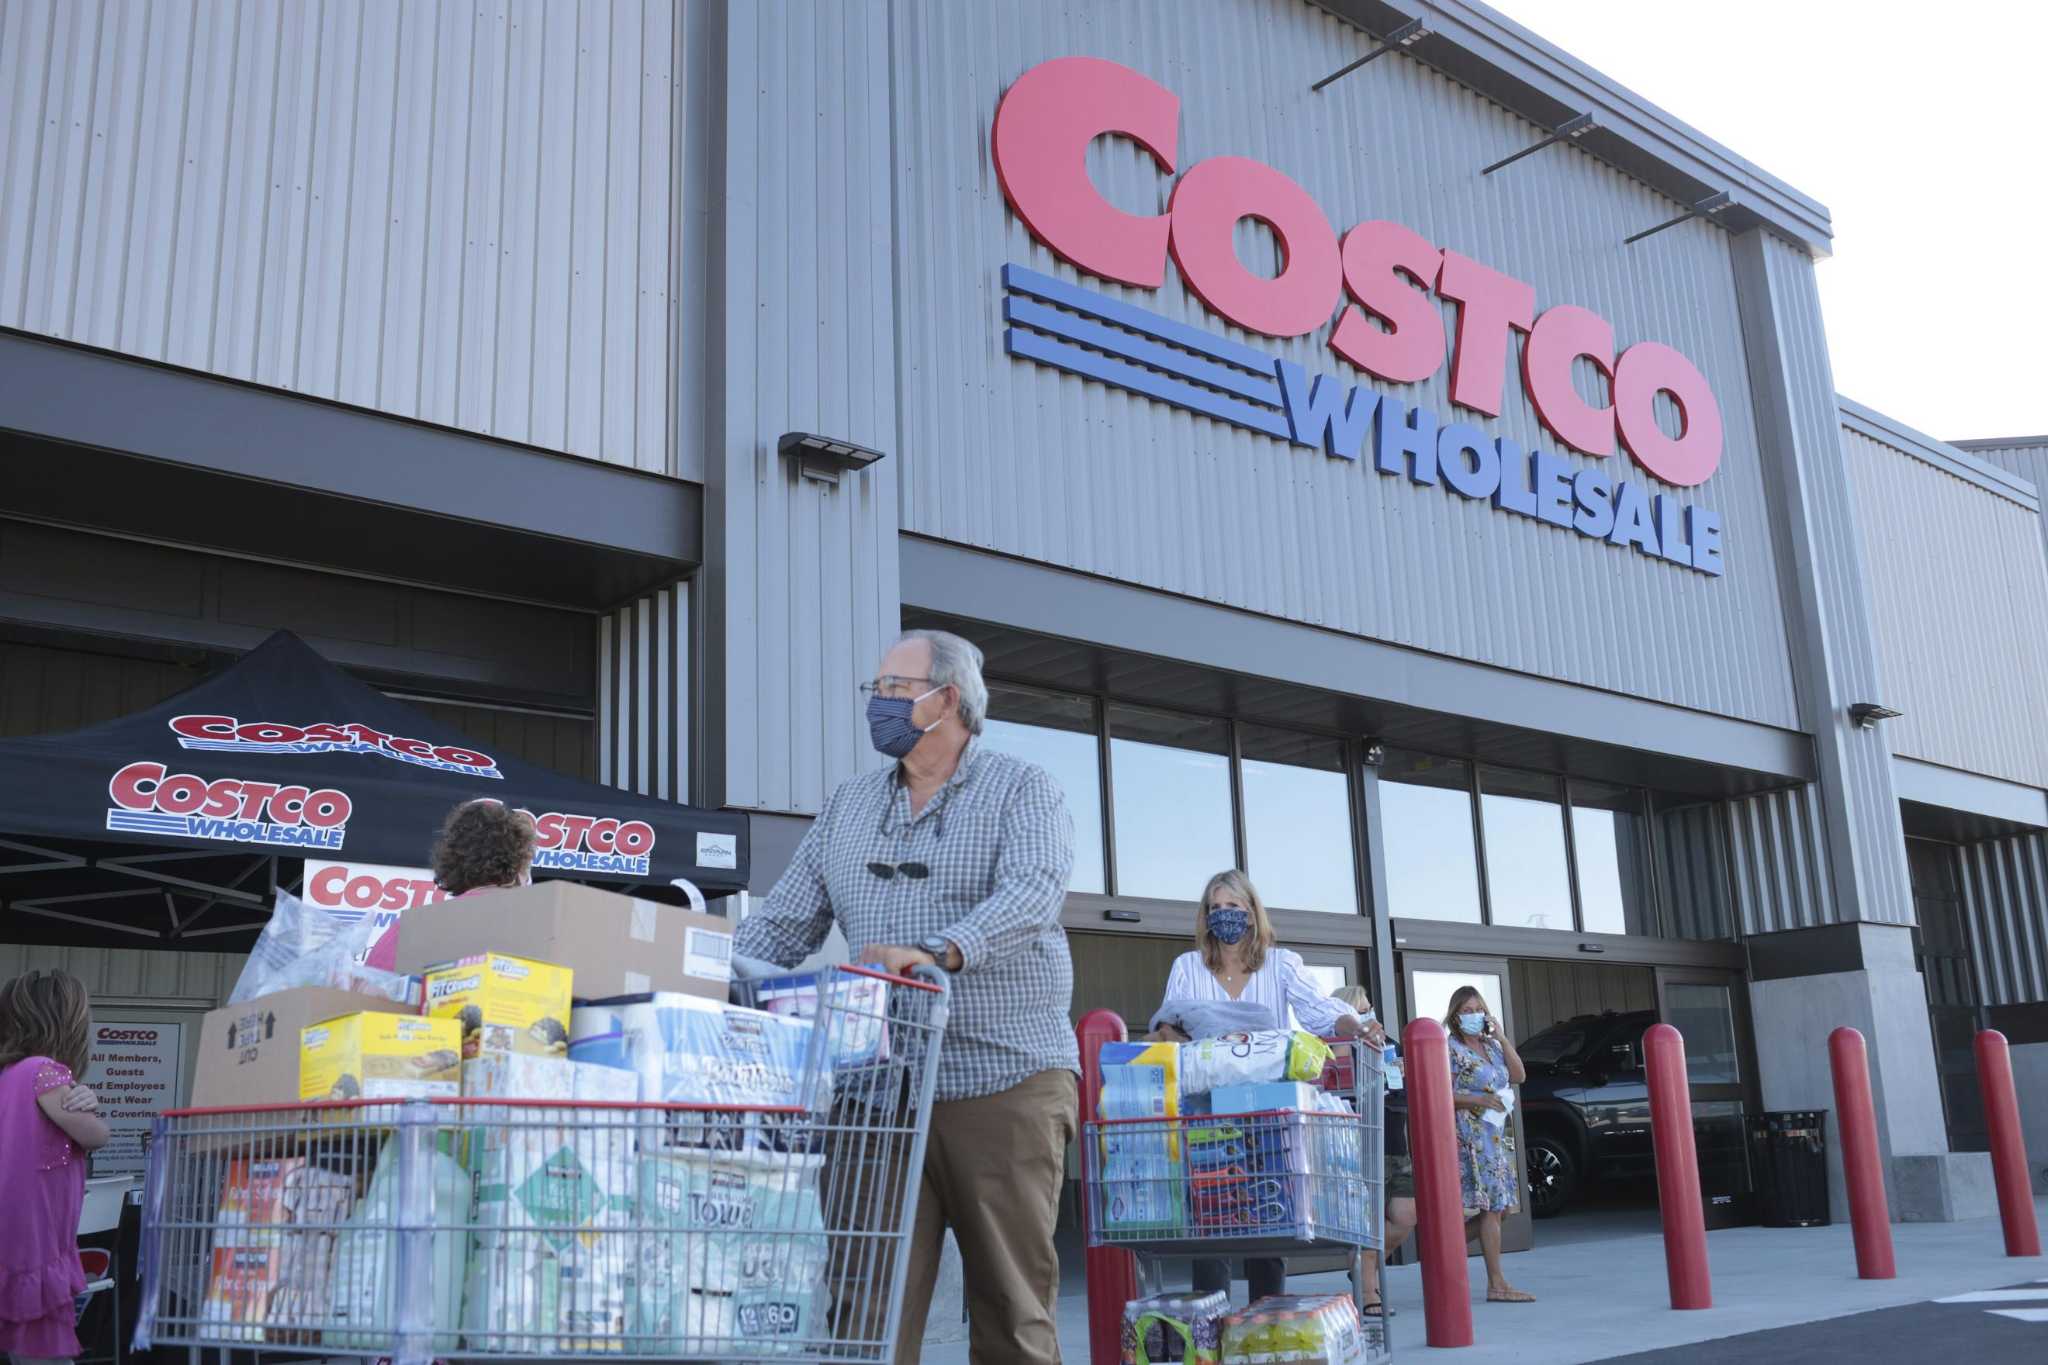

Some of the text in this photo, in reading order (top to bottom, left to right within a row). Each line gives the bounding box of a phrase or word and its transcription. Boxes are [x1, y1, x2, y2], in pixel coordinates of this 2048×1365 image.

[991, 56, 1724, 487] COSTCO
[1274, 358, 1723, 576] WHOLESALE
[168, 715, 496, 768] COSTCO
[109, 761, 352, 828] COSTCO
[187, 817, 345, 849] WHOLESALE
[472, 799, 655, 857] STCO
[310, 866, 448, 910] COST
[97, 1028, 158, 1040] COSTCO
[91, 1054, 162, 1064] All Members,
[106, 1068, 144, 1076] Guests
[107, 1081, 165, 1092] Employees
[125, 1096, 152, 1104] Wear
